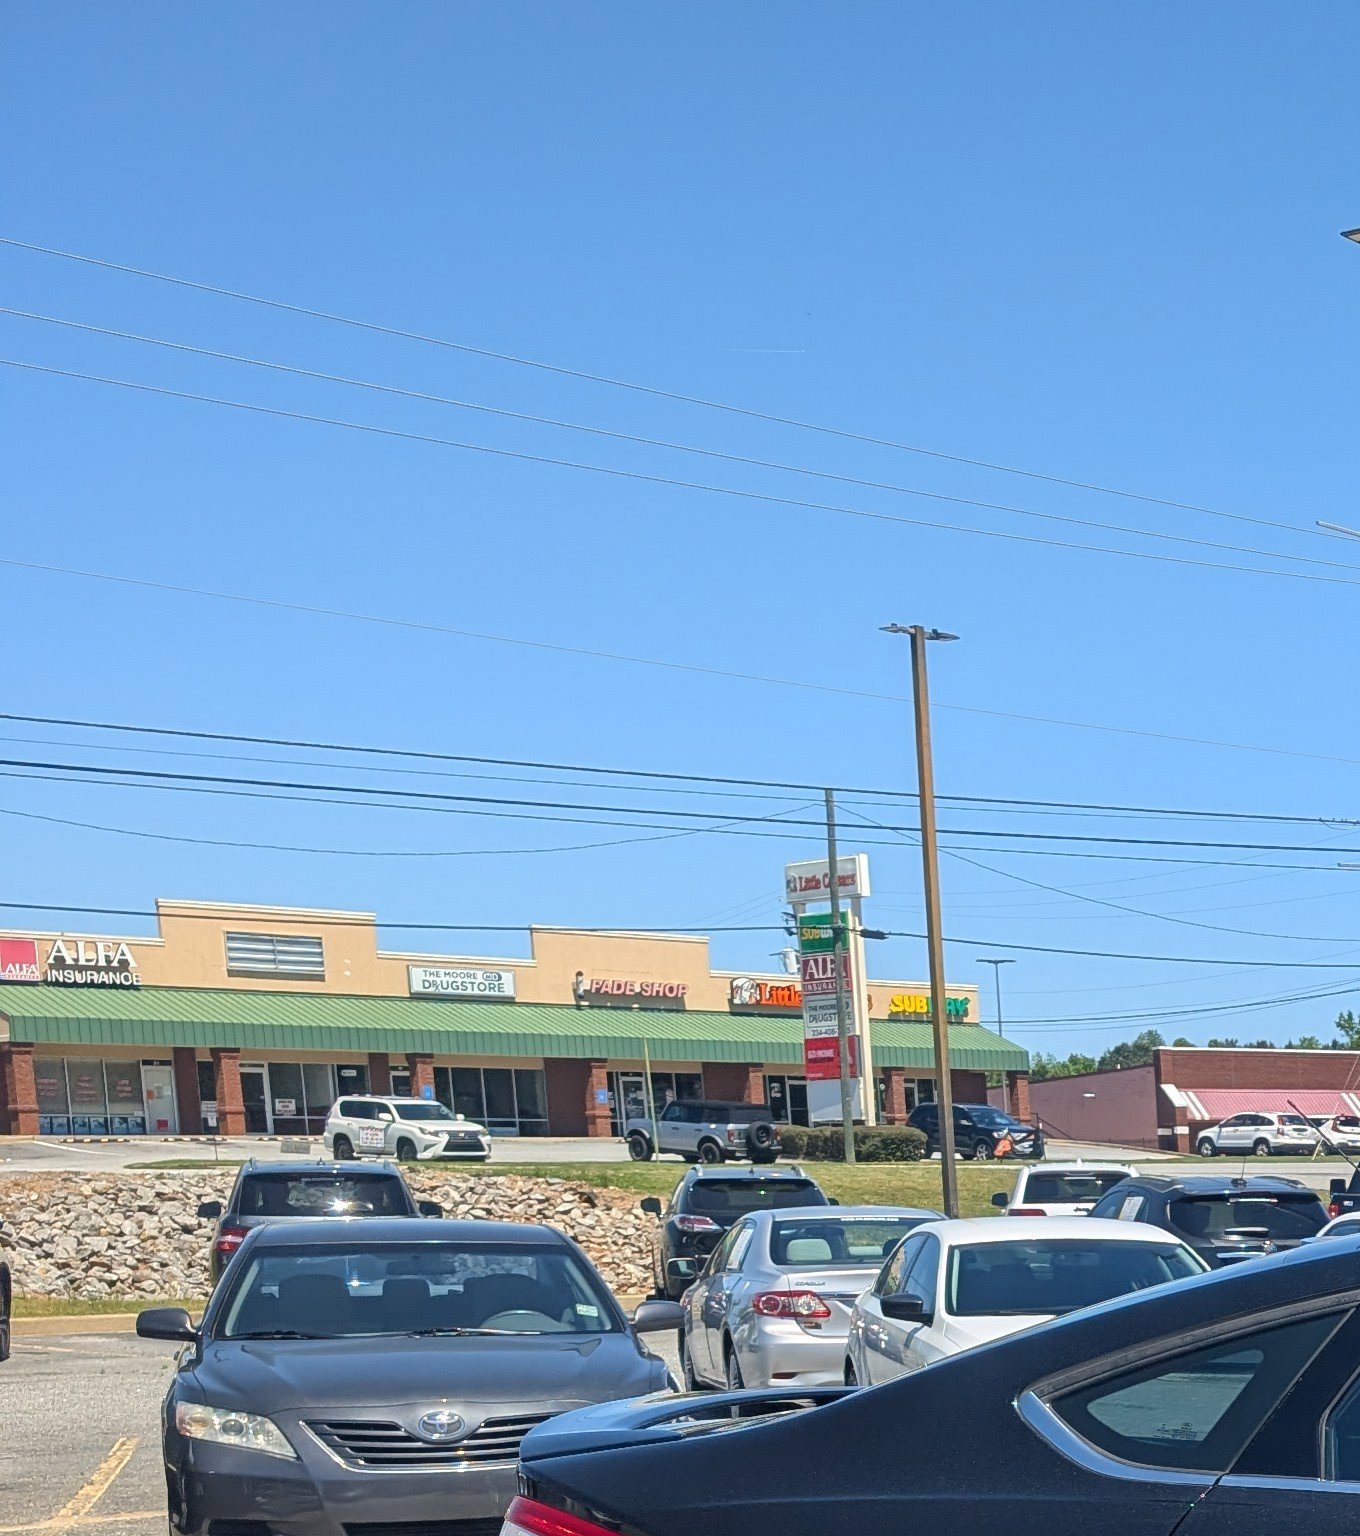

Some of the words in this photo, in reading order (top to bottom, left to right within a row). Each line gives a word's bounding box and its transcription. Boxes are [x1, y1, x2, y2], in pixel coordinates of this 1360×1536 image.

[47, 940, 138, 967] ALFA
[5, 963, 38, 974] ALFA
[423, 970, 442, 978] THE
[444, 971, 478, 980] MOORE
[805, 955, 847, 979] ALF
[47, 969, 142, 985] INSURANCE
[591, 979, 636, 995] FADE
[640, 981, 689, 998] SHOP
